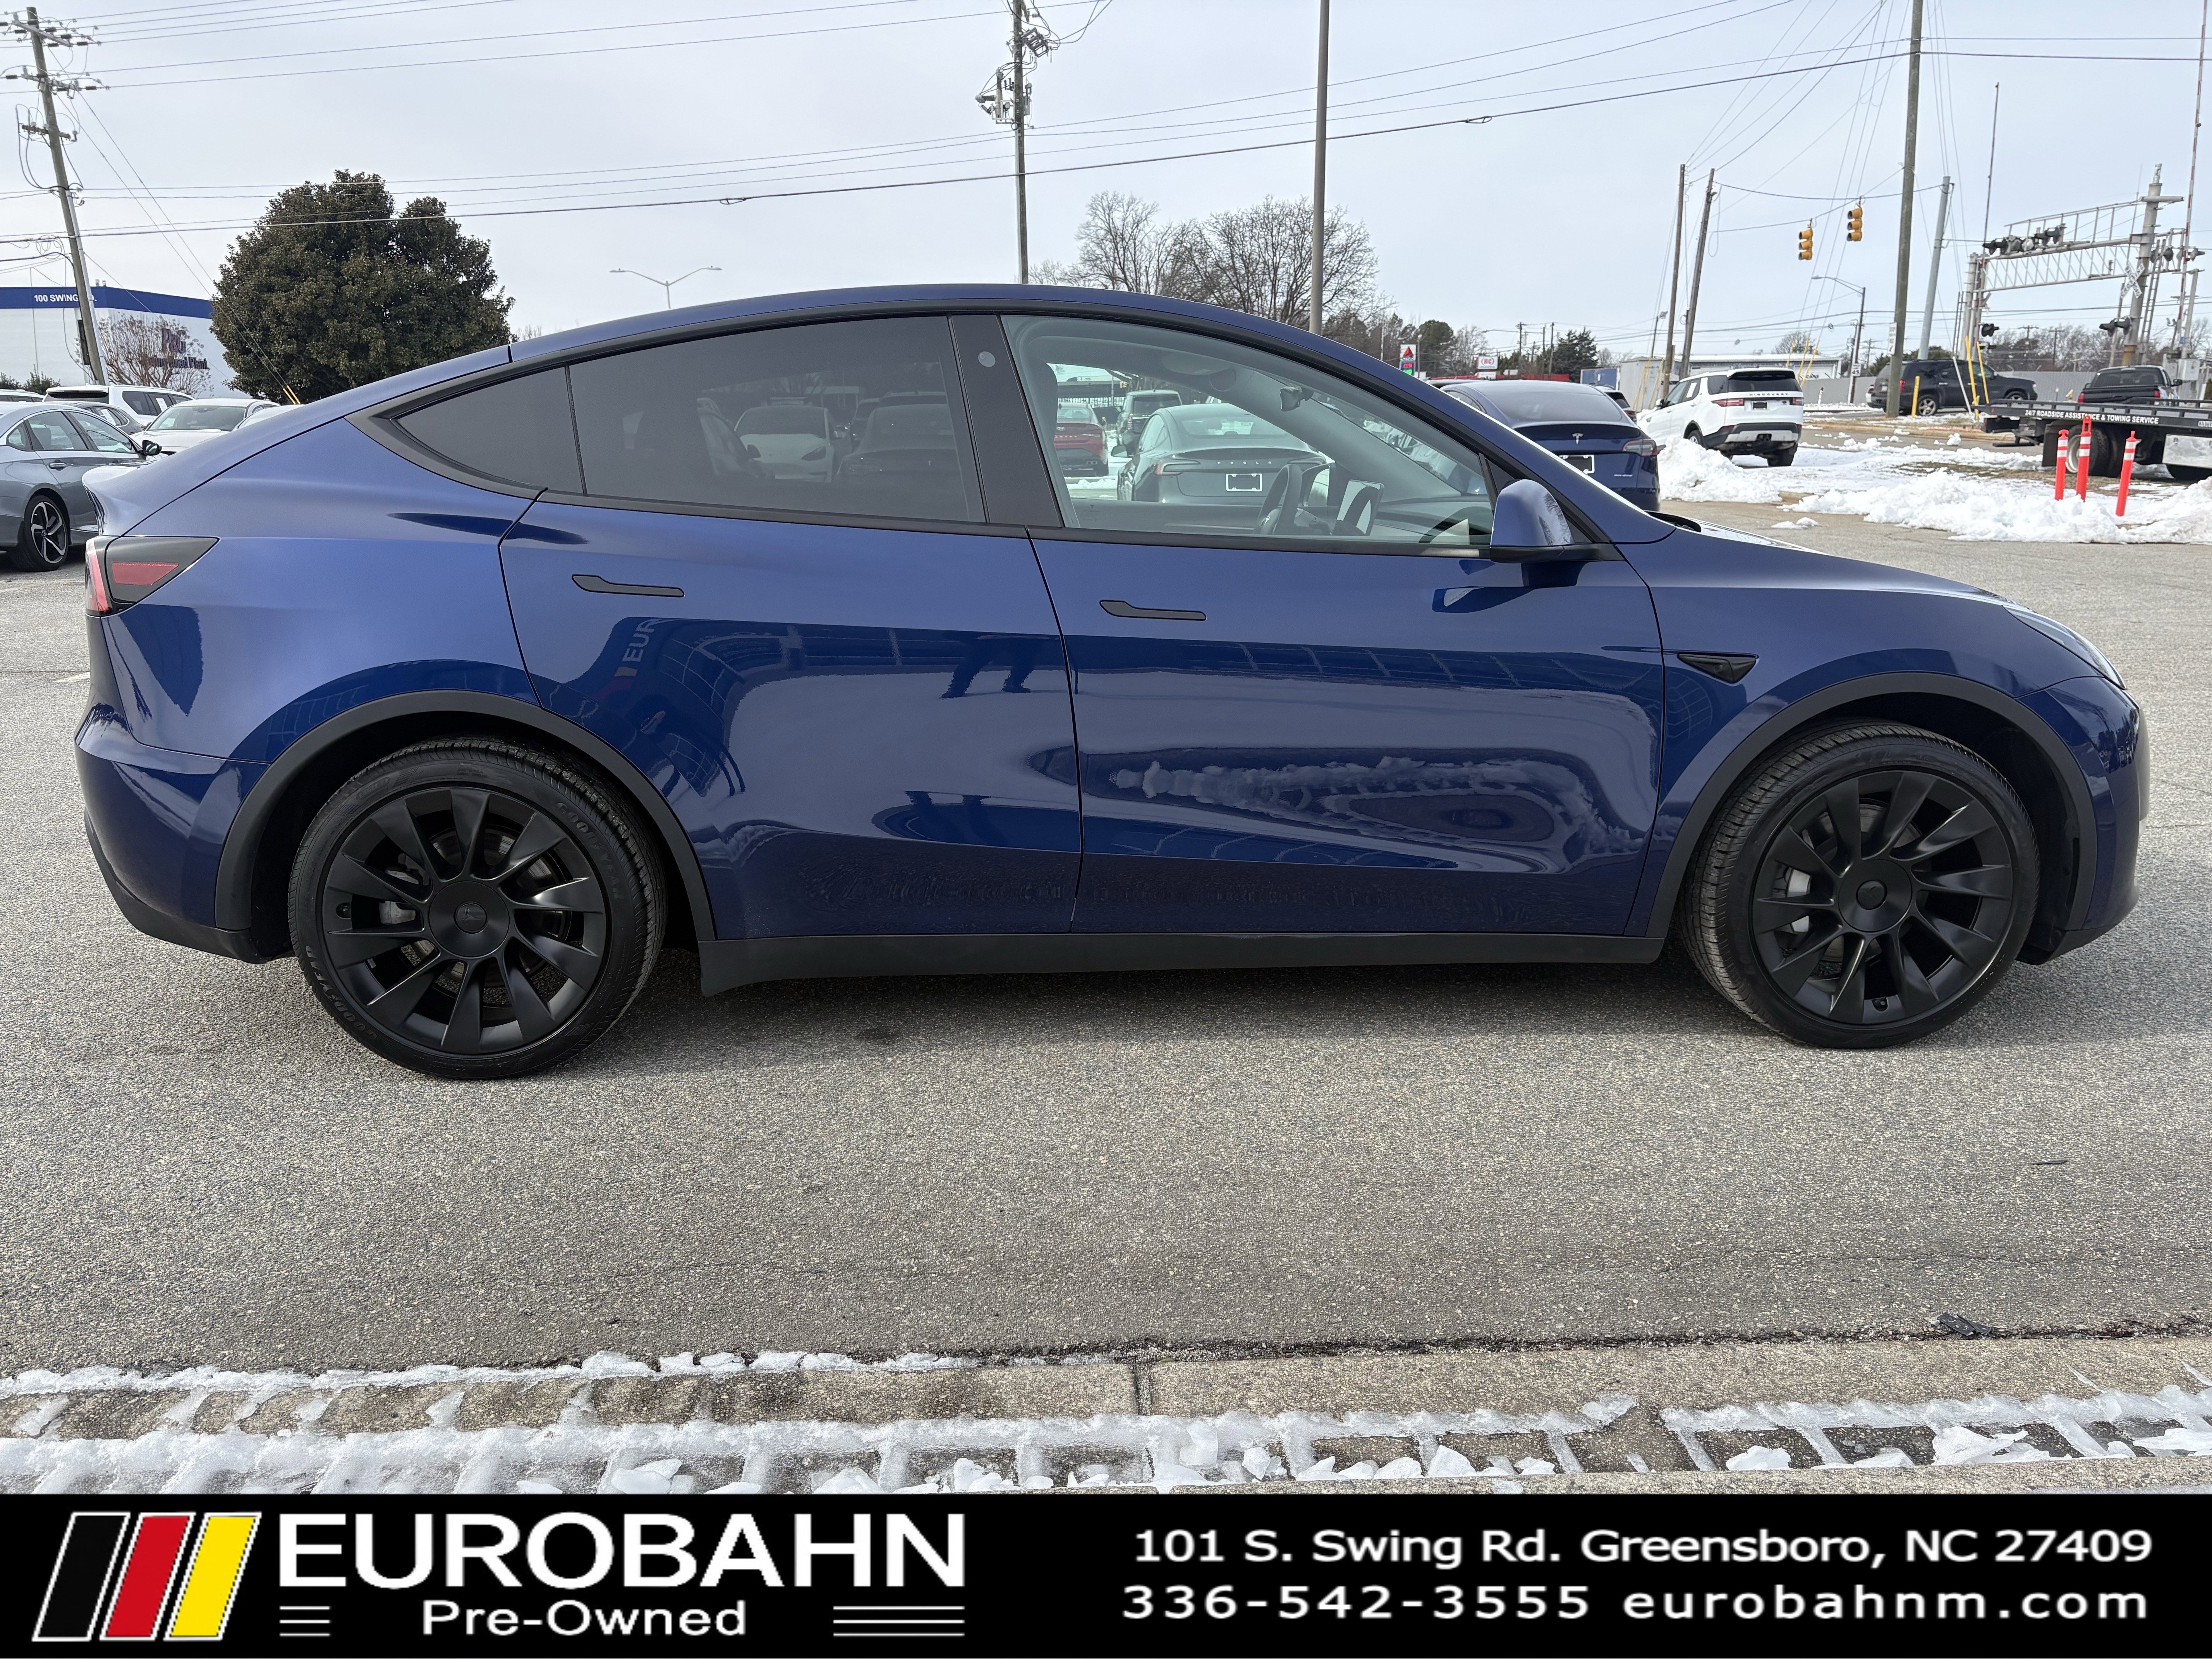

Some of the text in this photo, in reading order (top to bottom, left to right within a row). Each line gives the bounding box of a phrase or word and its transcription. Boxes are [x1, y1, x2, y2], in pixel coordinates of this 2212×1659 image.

[2036, 410, 2065, 418] ROADSIDE
[2107, 414, 2131, 422] TOWING
[2132, 416, 2159, 424] SERVICE
[305, 945, 378, 1040] GOODYEAR
